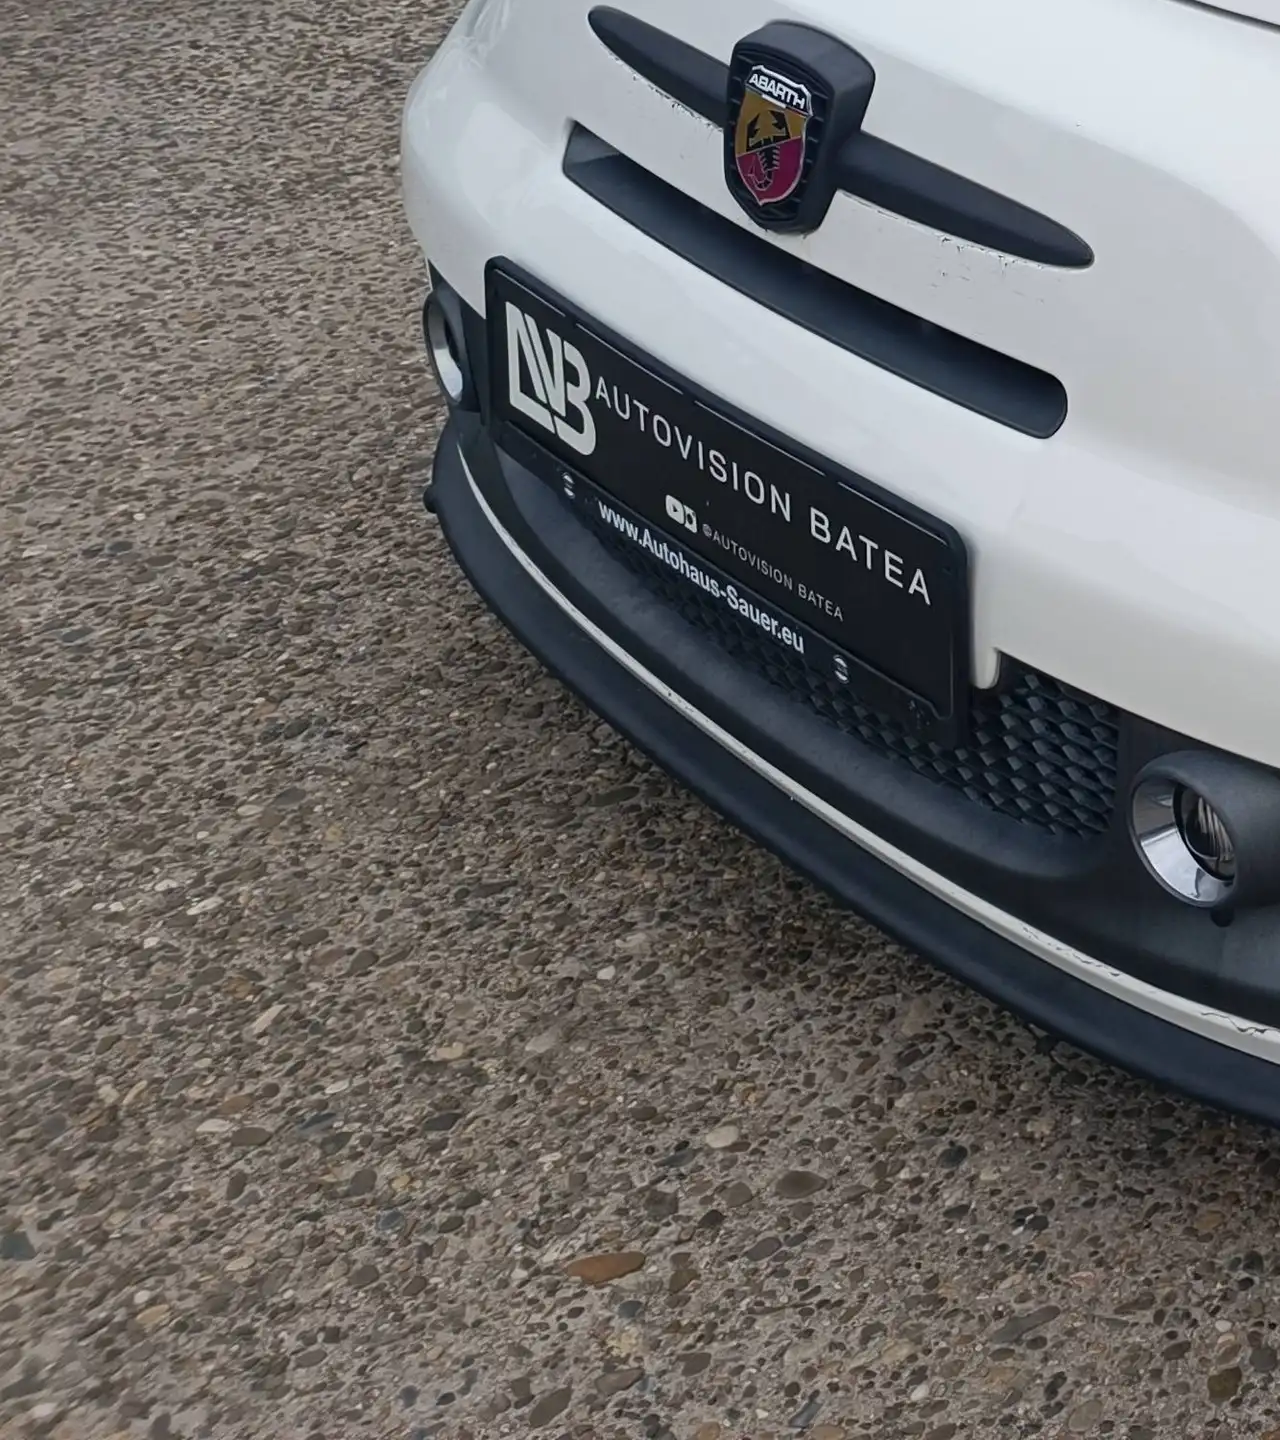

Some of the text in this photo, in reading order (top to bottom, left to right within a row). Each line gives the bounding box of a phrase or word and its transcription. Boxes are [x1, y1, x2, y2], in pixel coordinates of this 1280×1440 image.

[749, 73, 806, 109] ABARTH
[595, 375, 932, 607] AUTOVISION BATEA
[598, 499, 806, 655] www.Autohaus-Sauer.eu
[797, 582, 844, 622] BATEA
